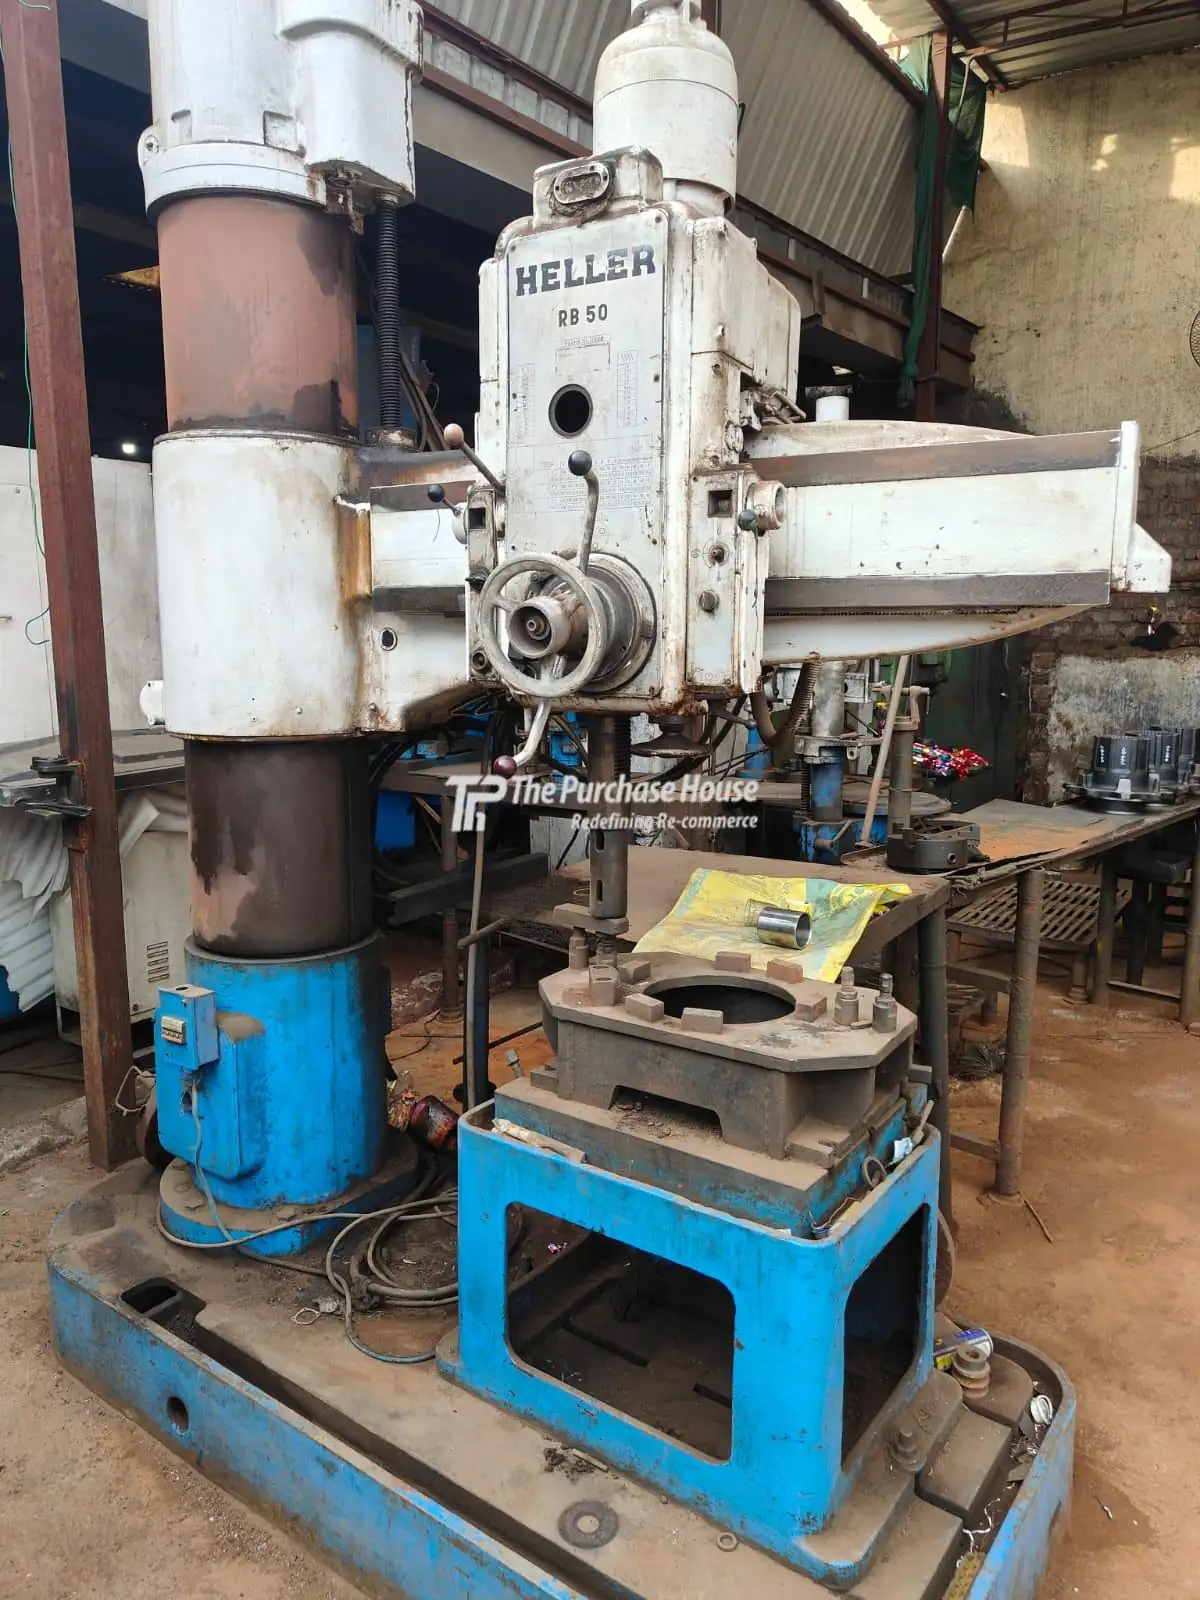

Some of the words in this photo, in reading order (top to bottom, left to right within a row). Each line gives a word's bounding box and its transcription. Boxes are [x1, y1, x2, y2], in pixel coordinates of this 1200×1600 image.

[516, 244, 656, 296] HELLER
[558, 308, 580, 327] RB
[586, 303, 608, 323] 50
